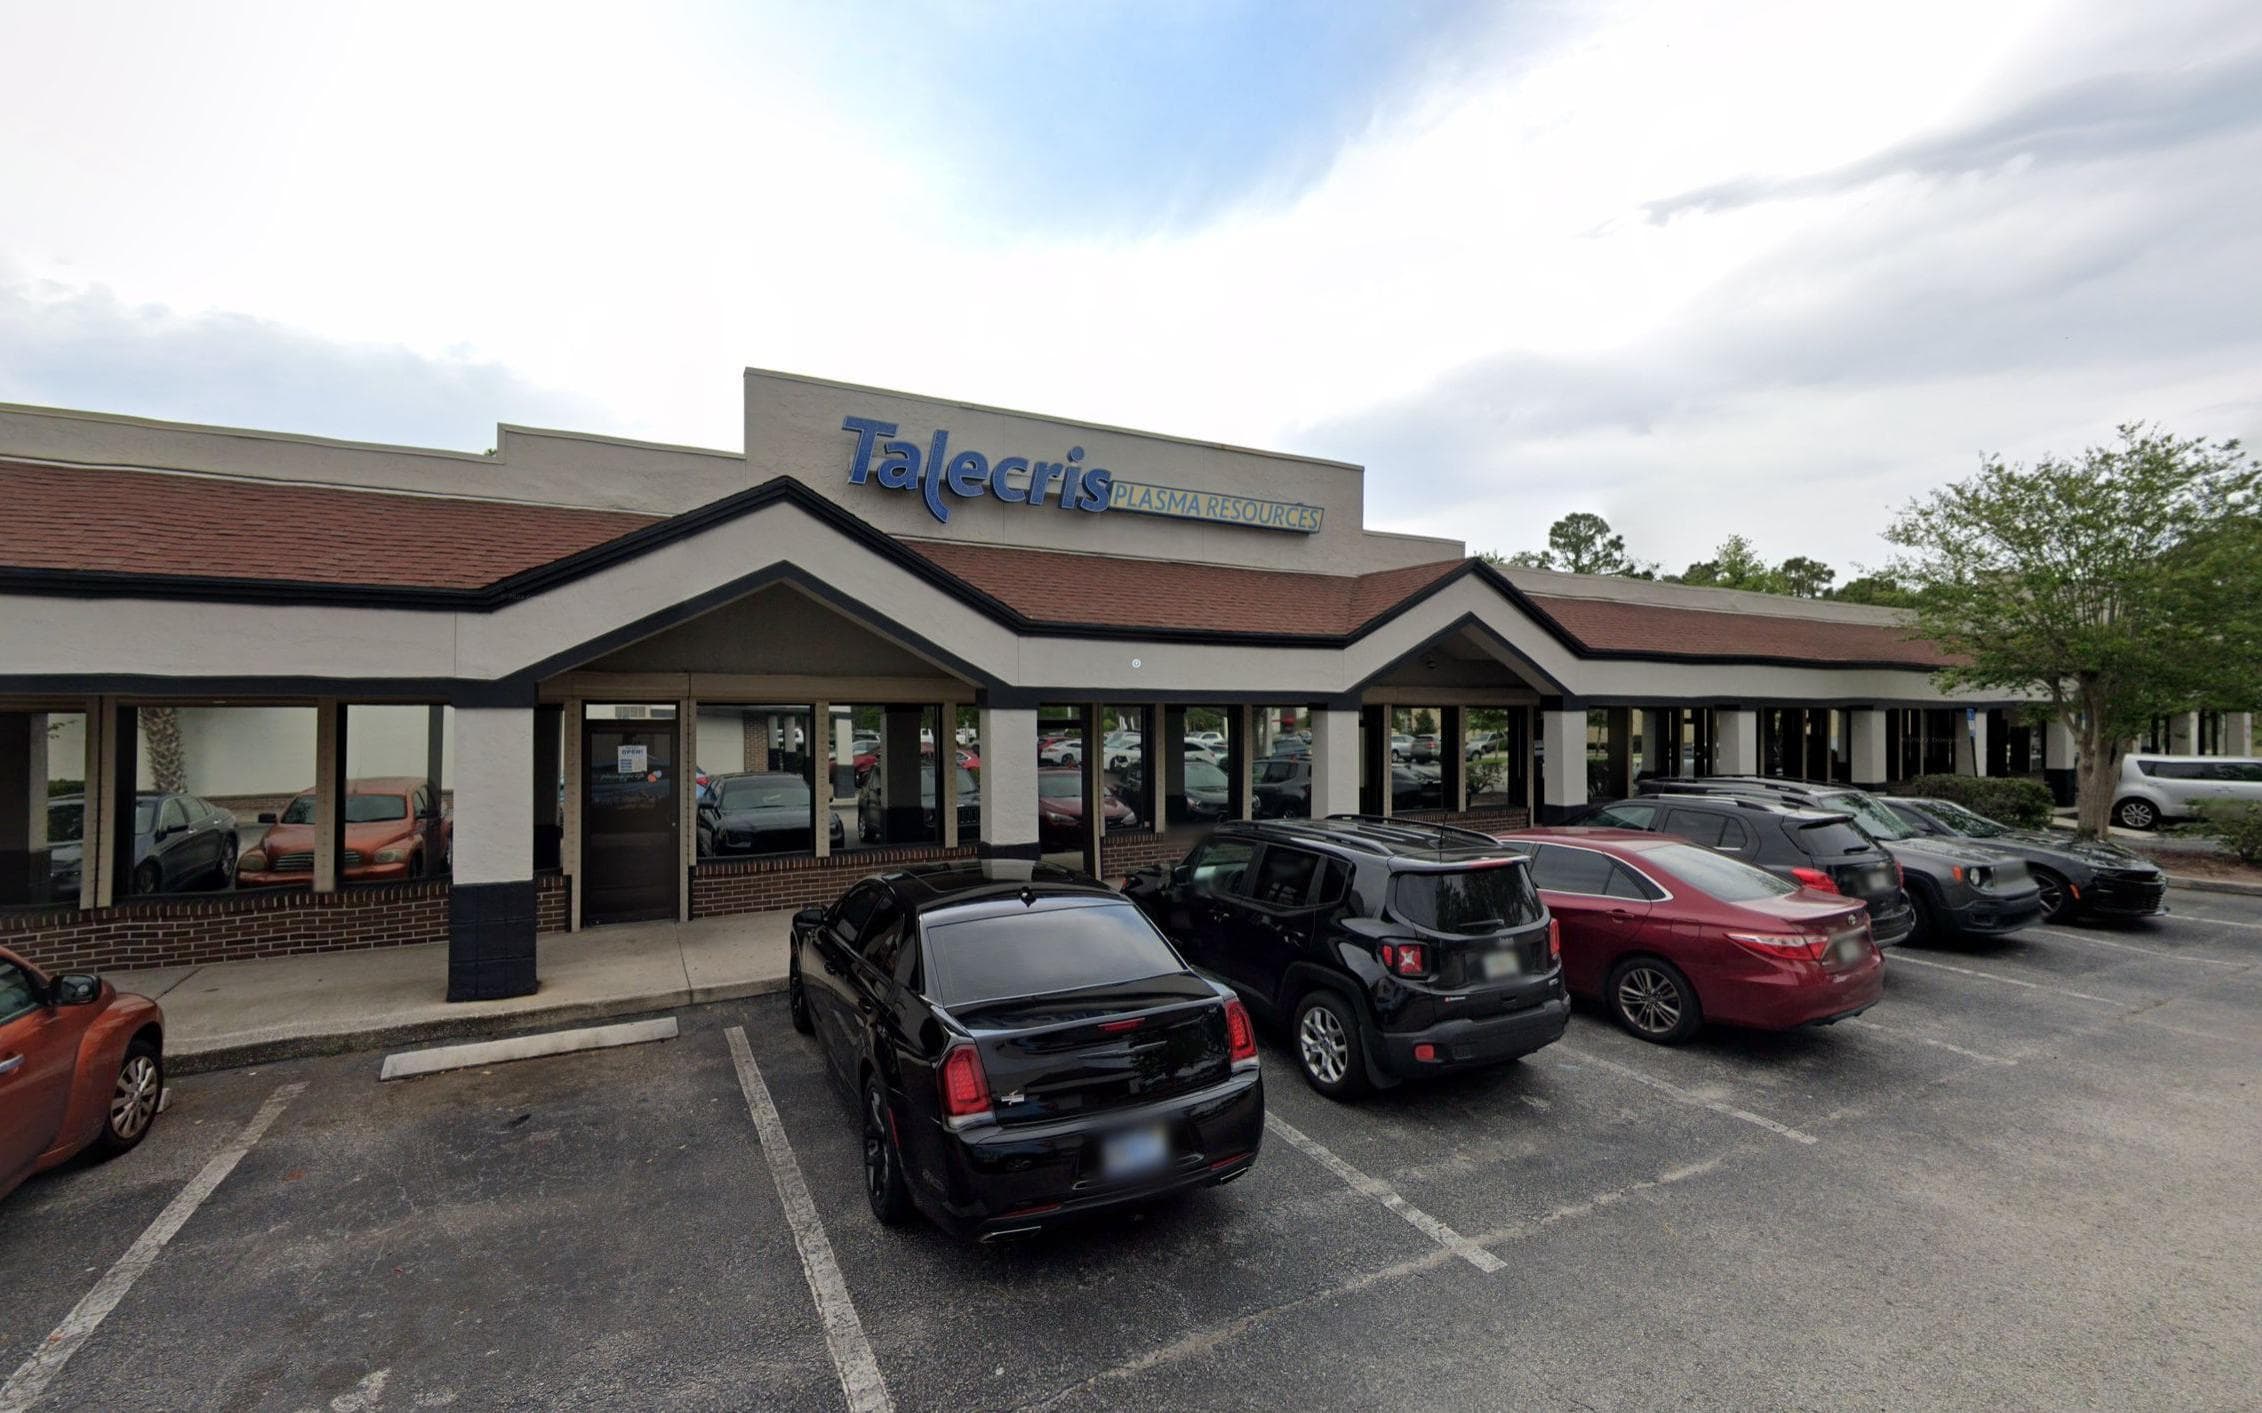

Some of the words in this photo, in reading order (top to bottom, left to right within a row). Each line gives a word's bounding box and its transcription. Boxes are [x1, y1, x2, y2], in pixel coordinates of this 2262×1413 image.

[842, 416, 1112, 523] Talecris
[1113, 485, 1200, 516] PLASMA
[1206, 496, 1320, 530] RESOURCES
